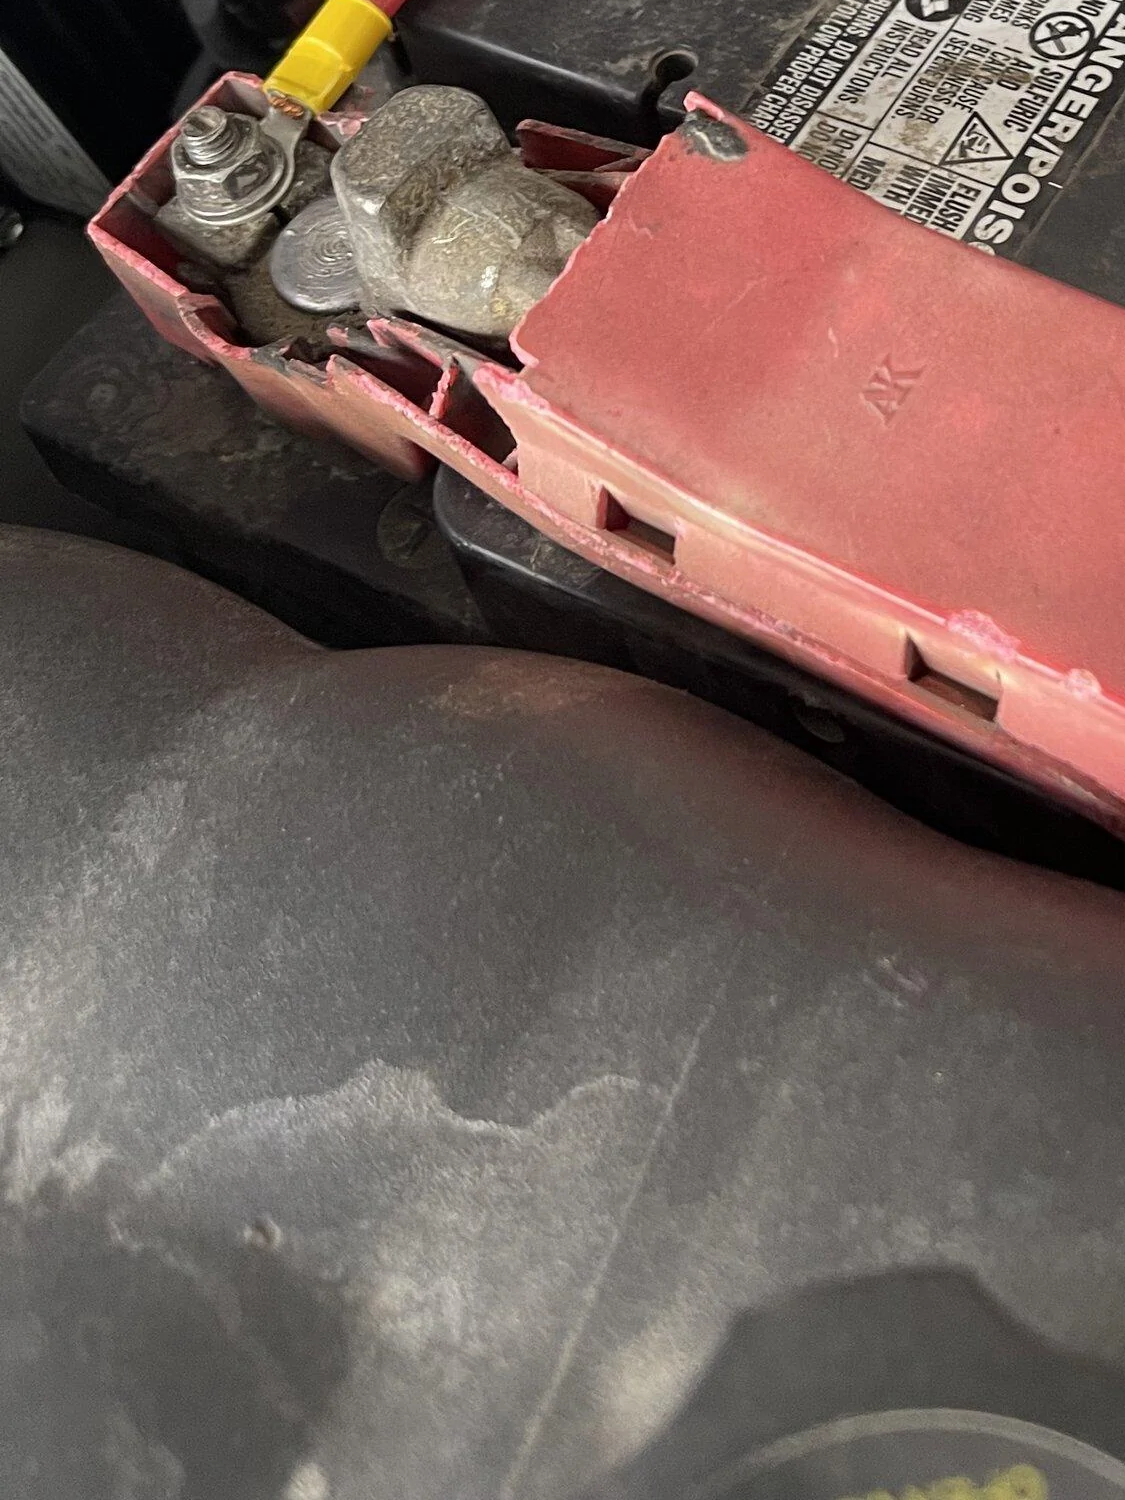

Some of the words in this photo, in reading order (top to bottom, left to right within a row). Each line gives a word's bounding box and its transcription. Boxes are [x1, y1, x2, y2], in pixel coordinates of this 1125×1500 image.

[827, 40, 857, 60] DO
[899, 27, 936, 58] READ
[923, 36, 967, 78] SEVERE
[771, 44, 825, 94] PROPER
[806, 58, 844, 87] NOT
[833, 19, 914, 108] INSTRUCTIONS.
[880, 57, 913, 82] ALL
[929, 43, 989, 105] BLINDNESS
[980, 50, 1011, 75] CAN
[890, 77, 937, 123] BURNS.
[951, 74, 994, 112] CAUSE
[1001, 66, 1064, 133] SULFURIC
[807, 120, 839, 143] DO
[916, 104, 944, 124] OR
[812, 148, 846, 174] NO
[882, 164, 928, 204] WITH
[929, 182, 982, 232] FLUSH
